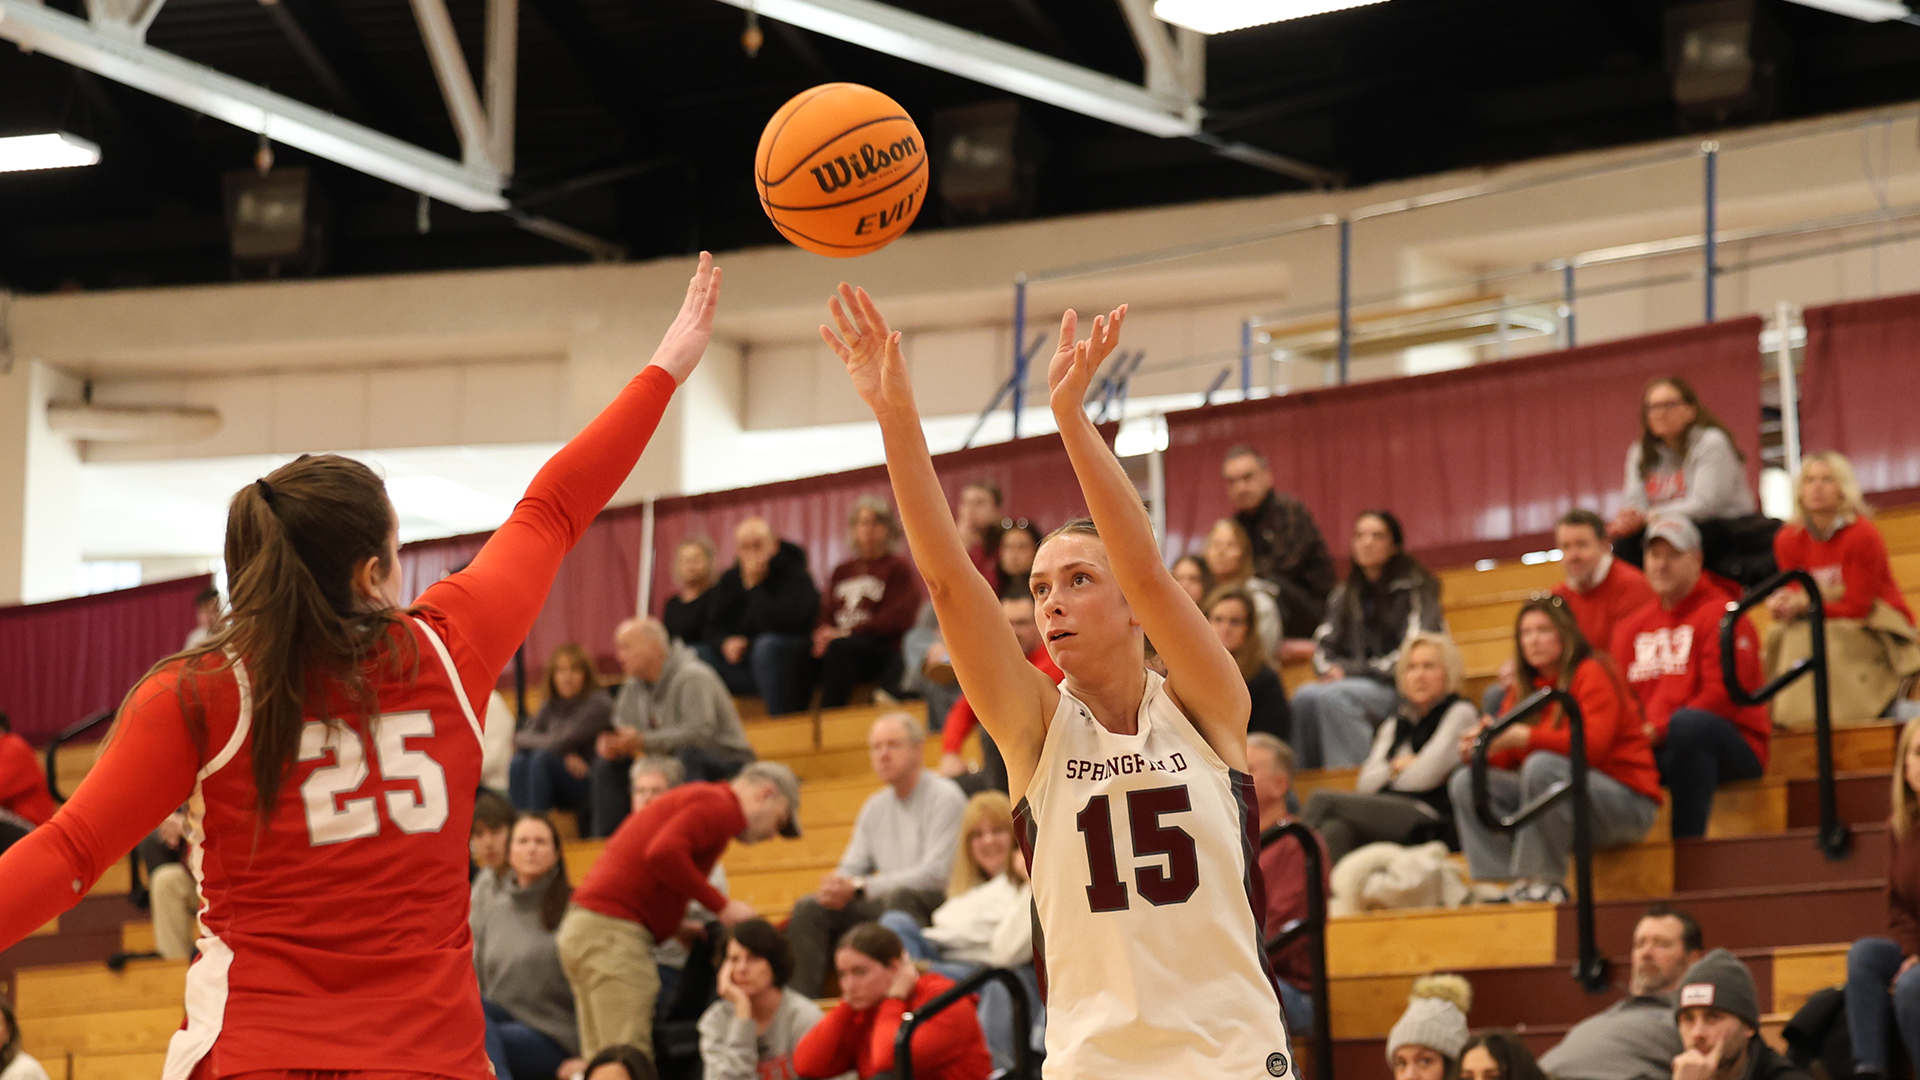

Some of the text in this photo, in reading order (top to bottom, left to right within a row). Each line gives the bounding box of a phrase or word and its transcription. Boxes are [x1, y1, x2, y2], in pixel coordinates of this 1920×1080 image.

[810, 135, 918, 193] Wilson
[297, 709, 449, 847] 25
[1077, 784, 1199, 913] 15
